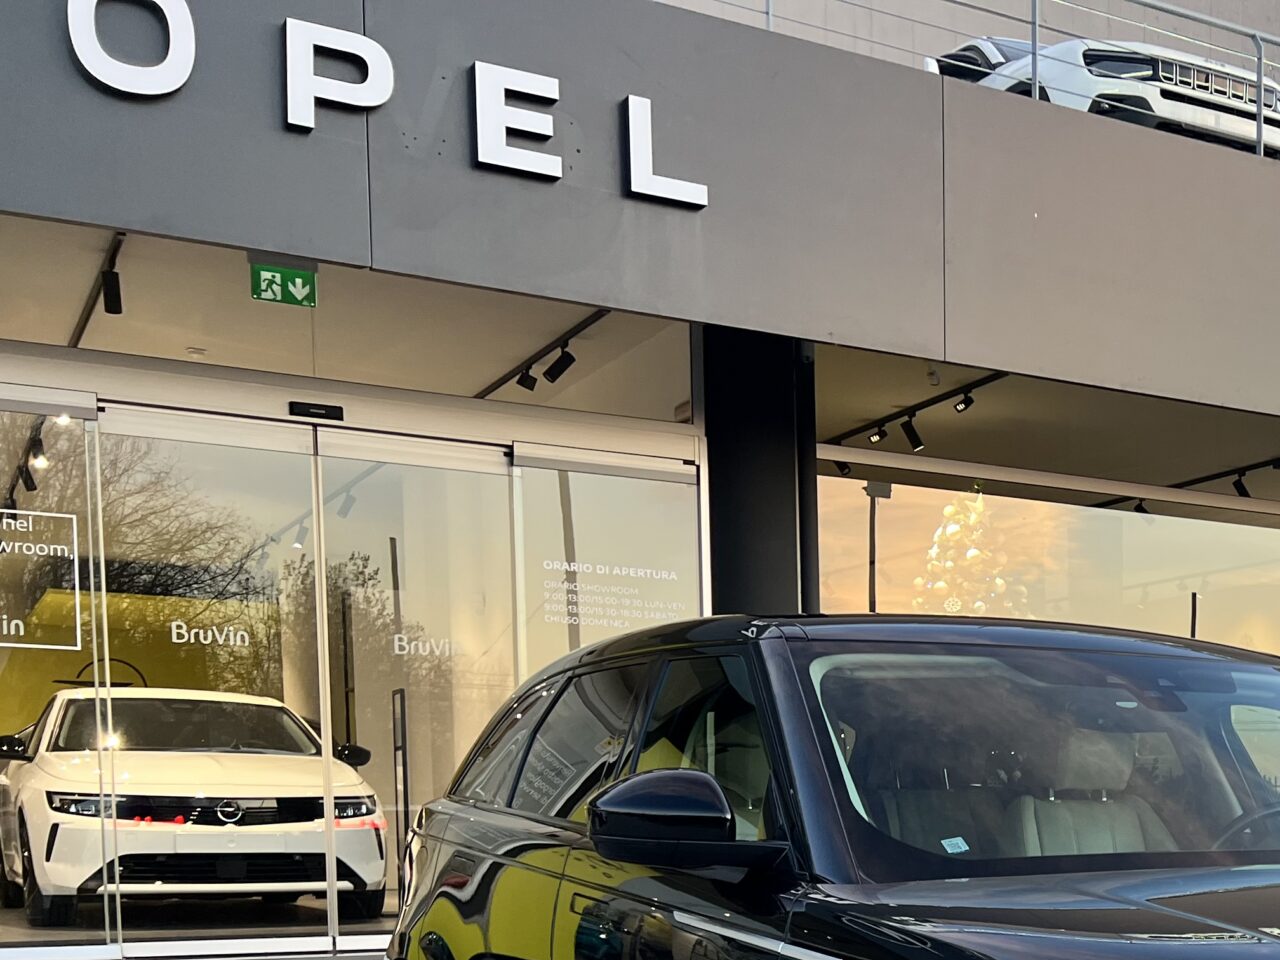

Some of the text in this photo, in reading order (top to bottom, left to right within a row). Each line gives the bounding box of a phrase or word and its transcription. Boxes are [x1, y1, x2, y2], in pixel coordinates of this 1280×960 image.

[66, 0, 709, 208] OPEL
[2, 516, 33, 532] nel
[543, 560, 678, 581] ORARIO DI APERTURA
[544, 580, 639, 595] ORARIO SHOWROOM
[544, 614, 579, 625] CHIUSO
